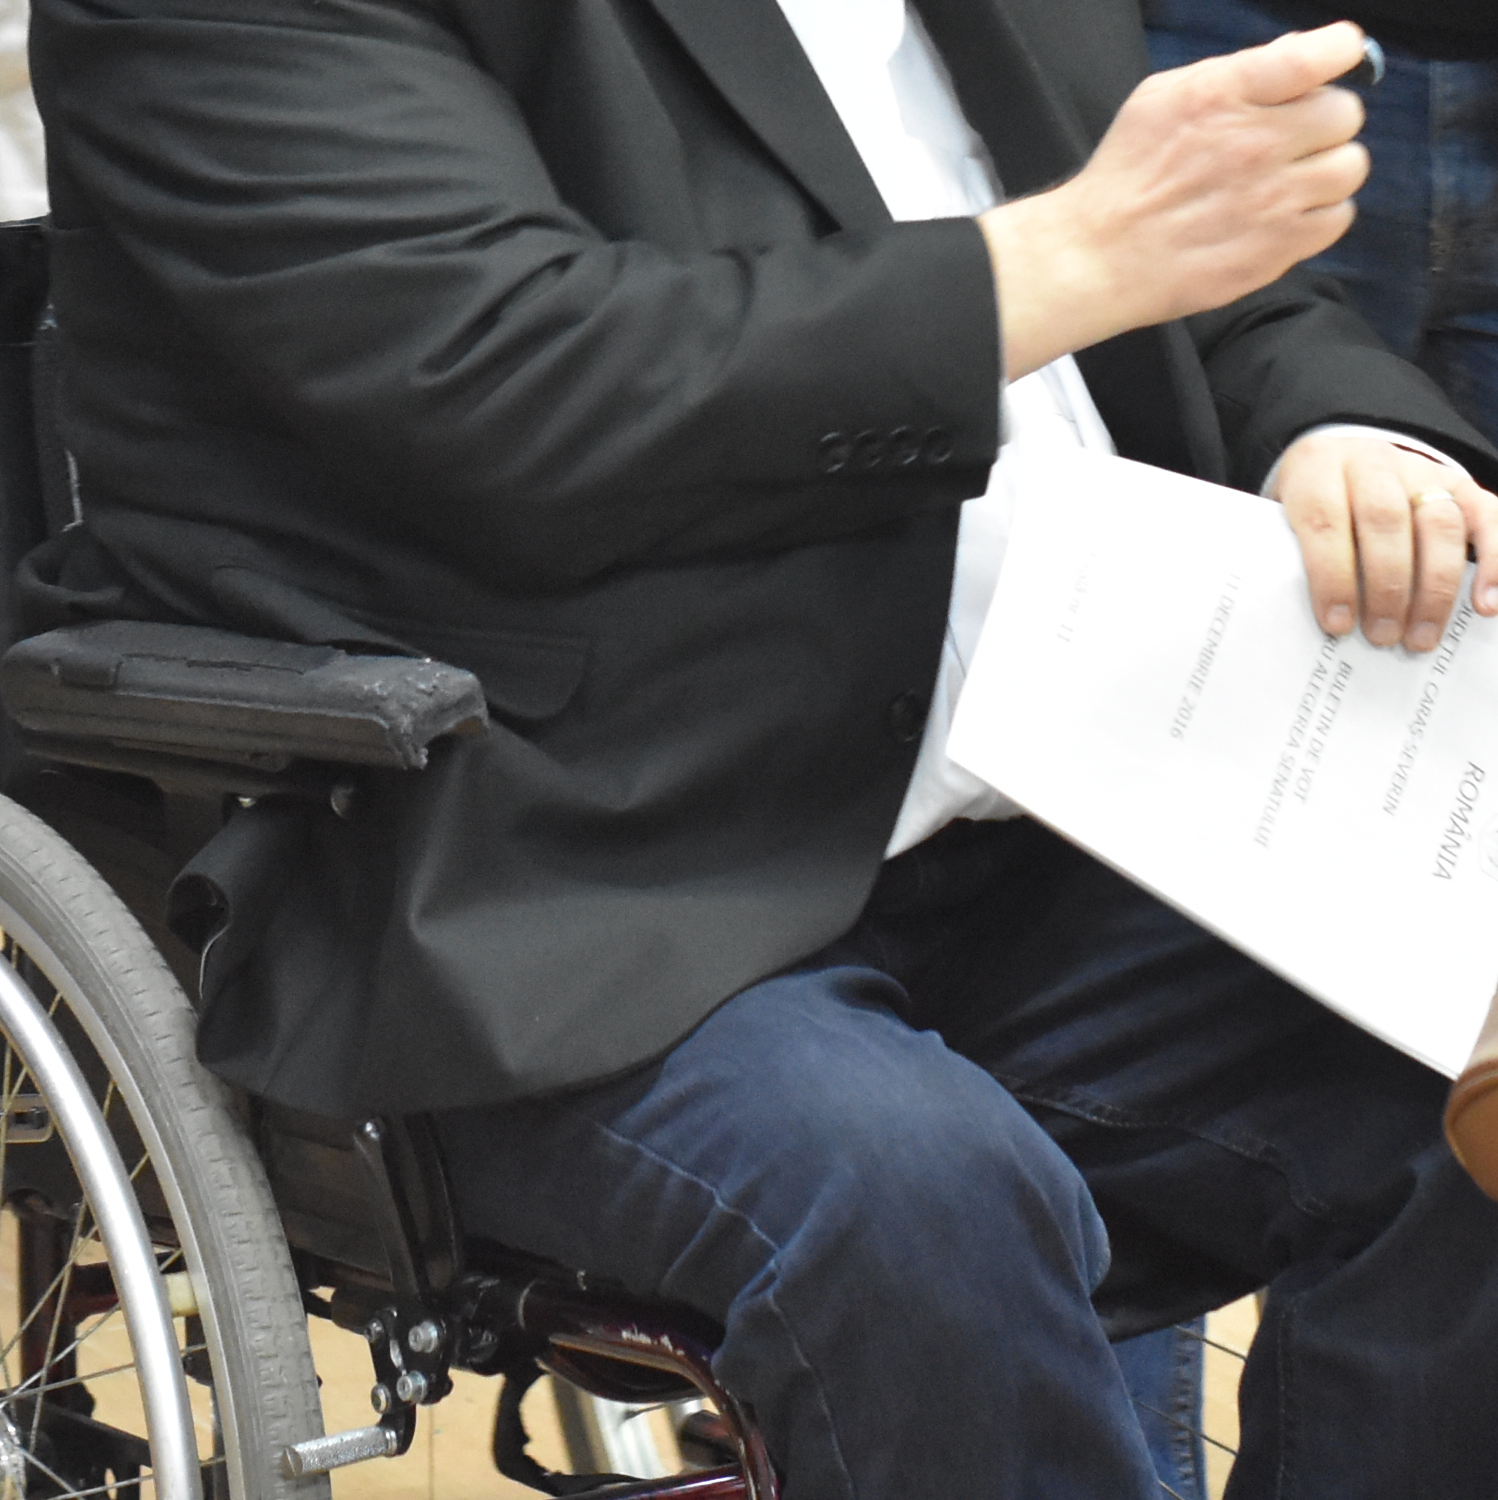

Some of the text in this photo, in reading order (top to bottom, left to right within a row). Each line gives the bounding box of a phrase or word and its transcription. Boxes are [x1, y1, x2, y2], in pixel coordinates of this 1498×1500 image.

[1186, 594, 1235, 696] DECEMBRIE
[1169, 696, 1197, 741] 2016
[1315, 660, 1354, 737] BULETIN
[1253, 660, 1328, 849] ALEGEREA SENATULUI
[1291, 766, 1316, 804] VOT
[1305, 736, 1325, 765] DE
[1432, 760, 1487, 881] ROMÂNIA
